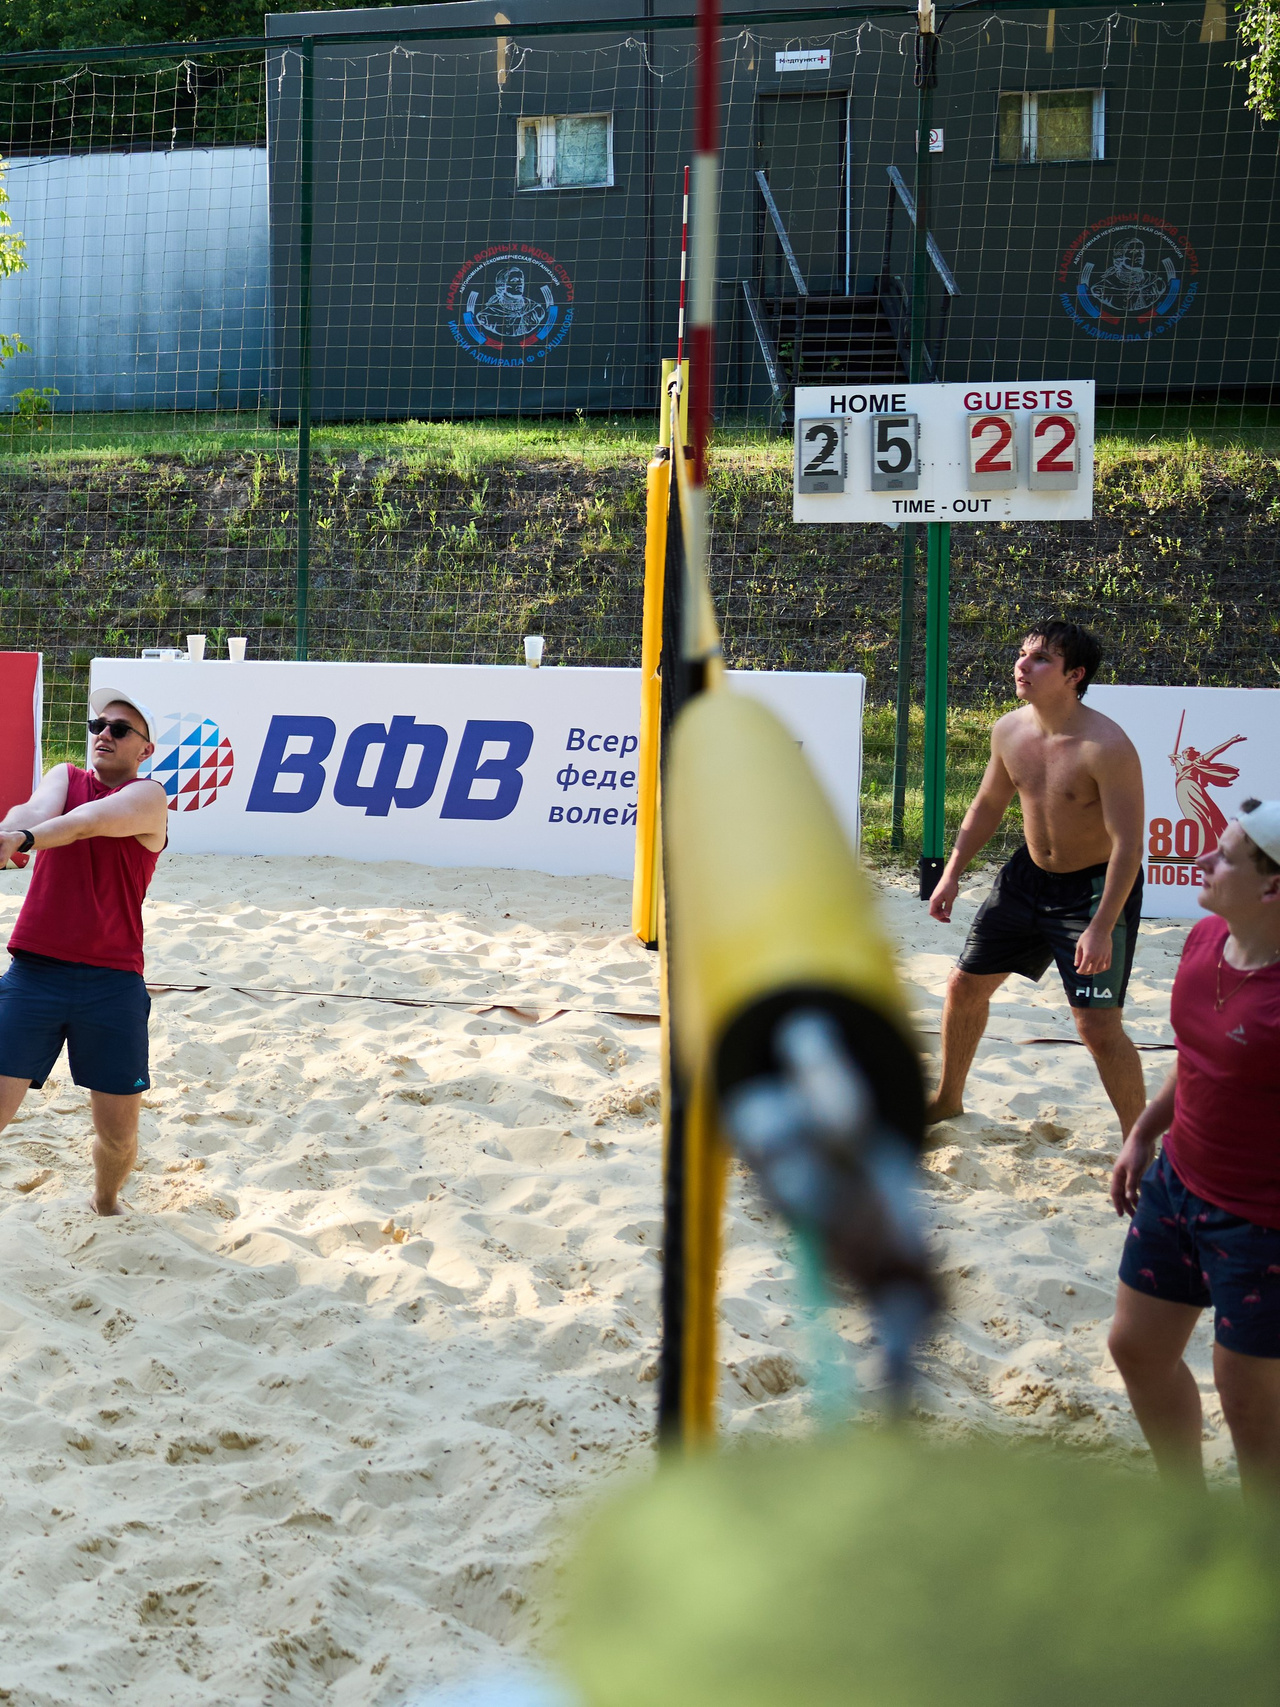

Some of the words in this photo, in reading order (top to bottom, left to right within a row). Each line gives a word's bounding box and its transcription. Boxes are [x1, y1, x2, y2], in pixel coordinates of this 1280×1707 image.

[830, 393, 907, 413] HOME
[963, 389, 1073, 411] GUESTS
[892, 499, 936, 513] TIME
[952, 499, 992, 513] OUT
[245, 714, 535, 821] ВФВ
[556, 763, 638, 794] феде
[1148, 817, 1199, 858] 80
[1147, 865, 1203, 887] ПОБЕ
[1075, 986, 1113, 999] FILA
